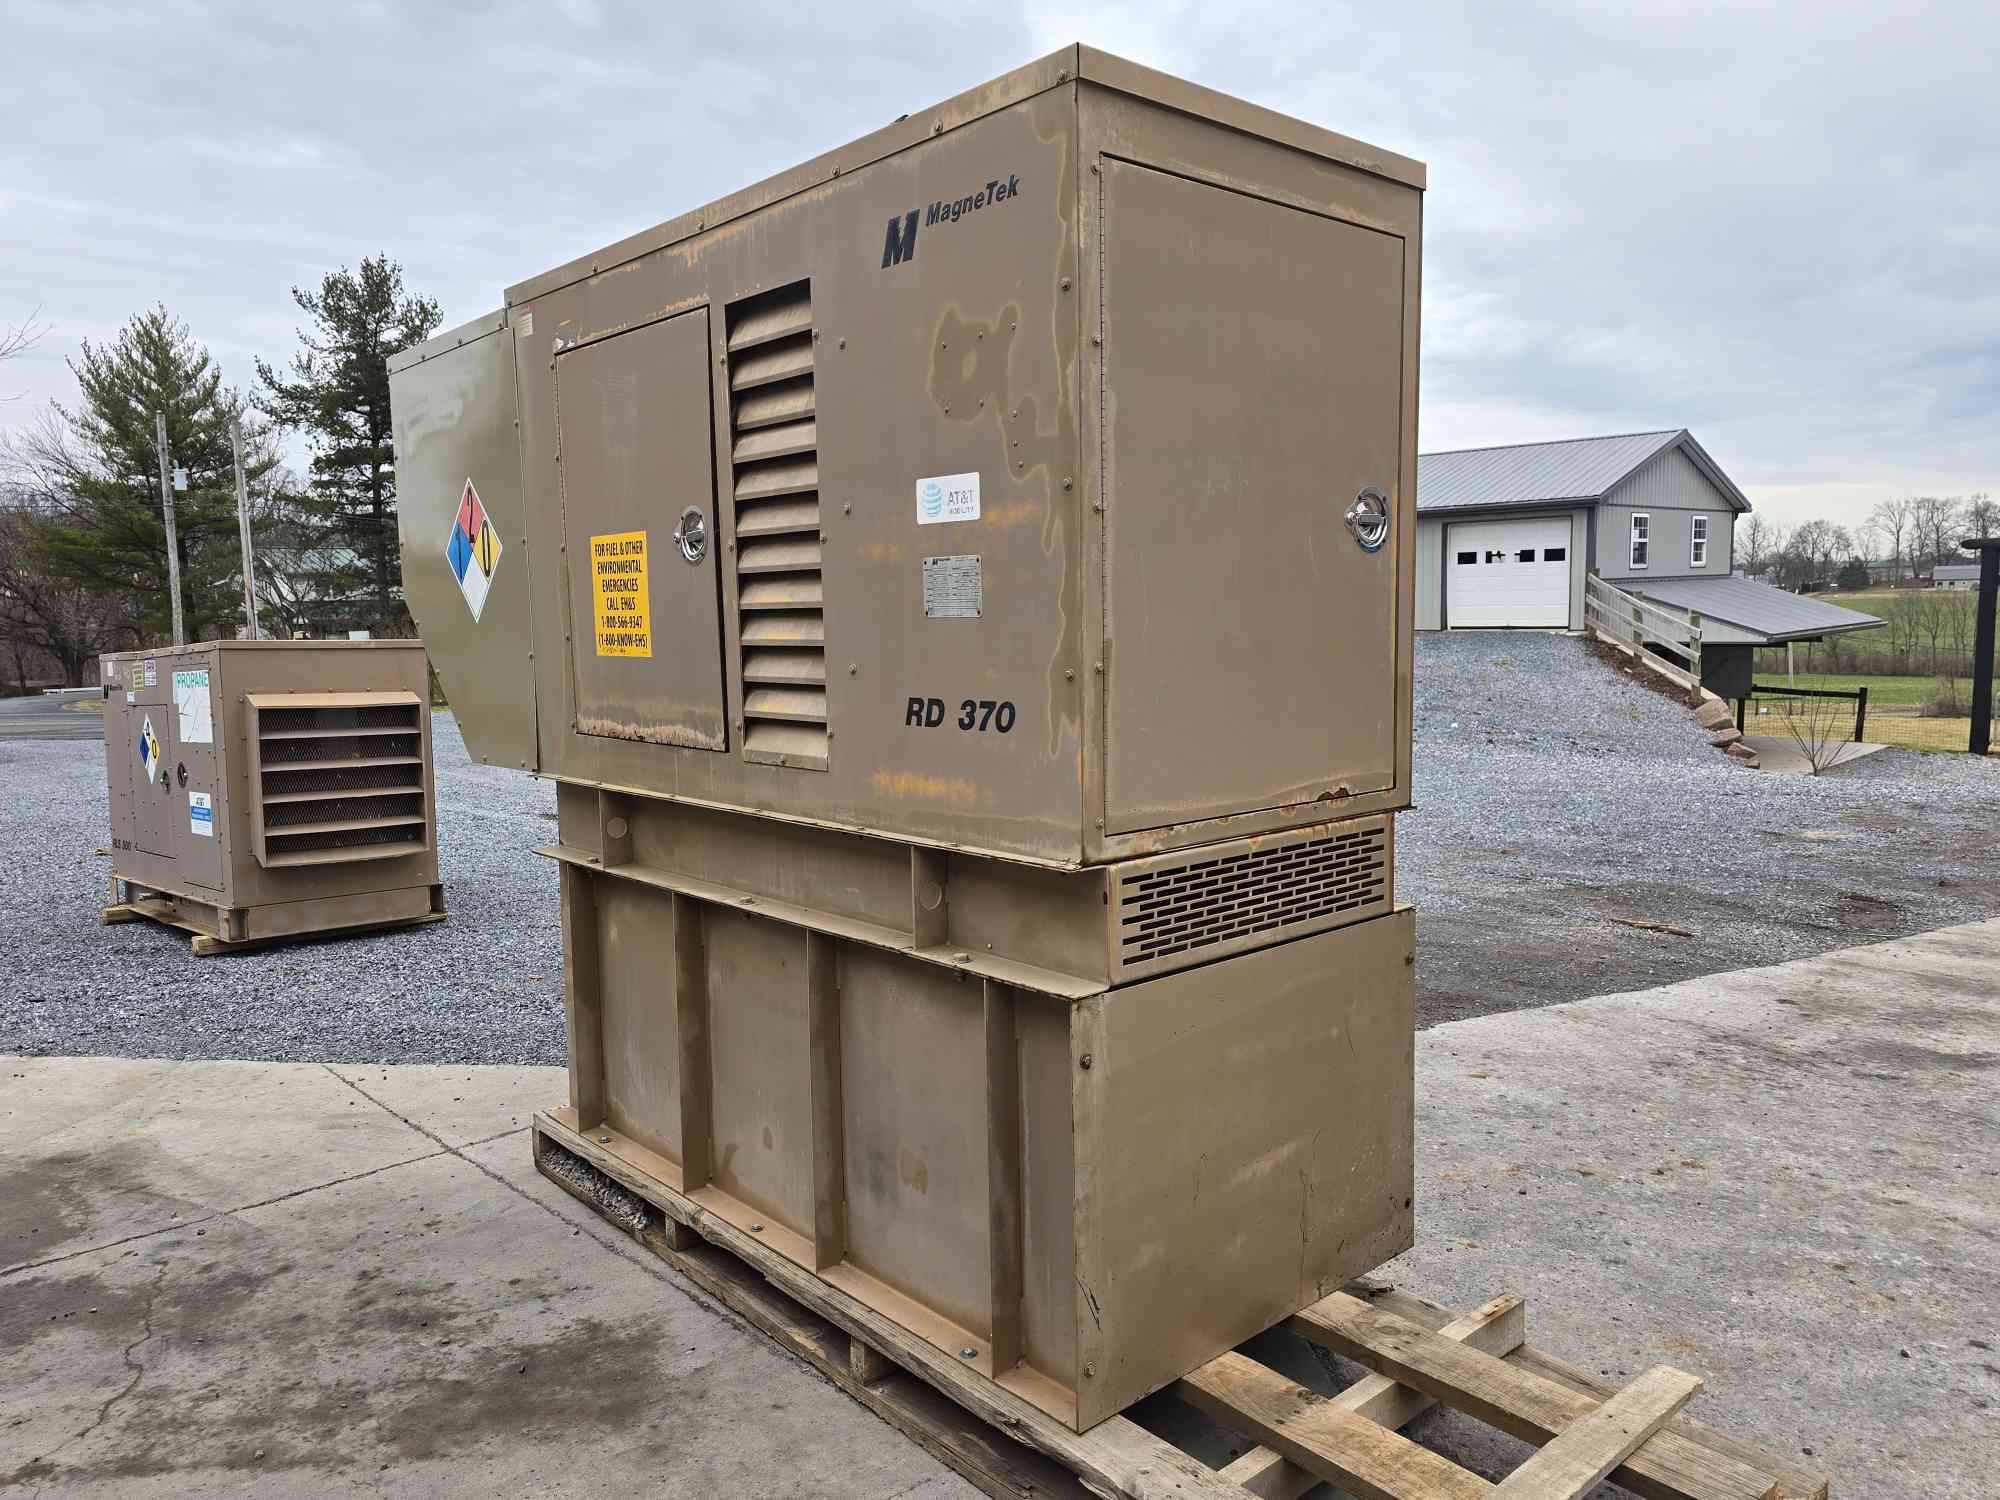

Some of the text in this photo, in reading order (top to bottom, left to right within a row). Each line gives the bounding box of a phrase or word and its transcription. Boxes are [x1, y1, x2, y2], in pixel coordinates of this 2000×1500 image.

[926, 174, 1020, 227] MagneTek
[947, 488, 974, 505] AT&T
[466, 486, 476, 544] 2
[595, 539, 643, 557] FOR FUEL & OTHER
[597, 559, 642, 575] ENVIRONMENTAL
[602, 577, 639, 593] EMERGENCIES
[606, 597, 619, 611] CALL
[176, 672, 208, 689] PROPANE
[904, 696, 1016, 734] RD 370
